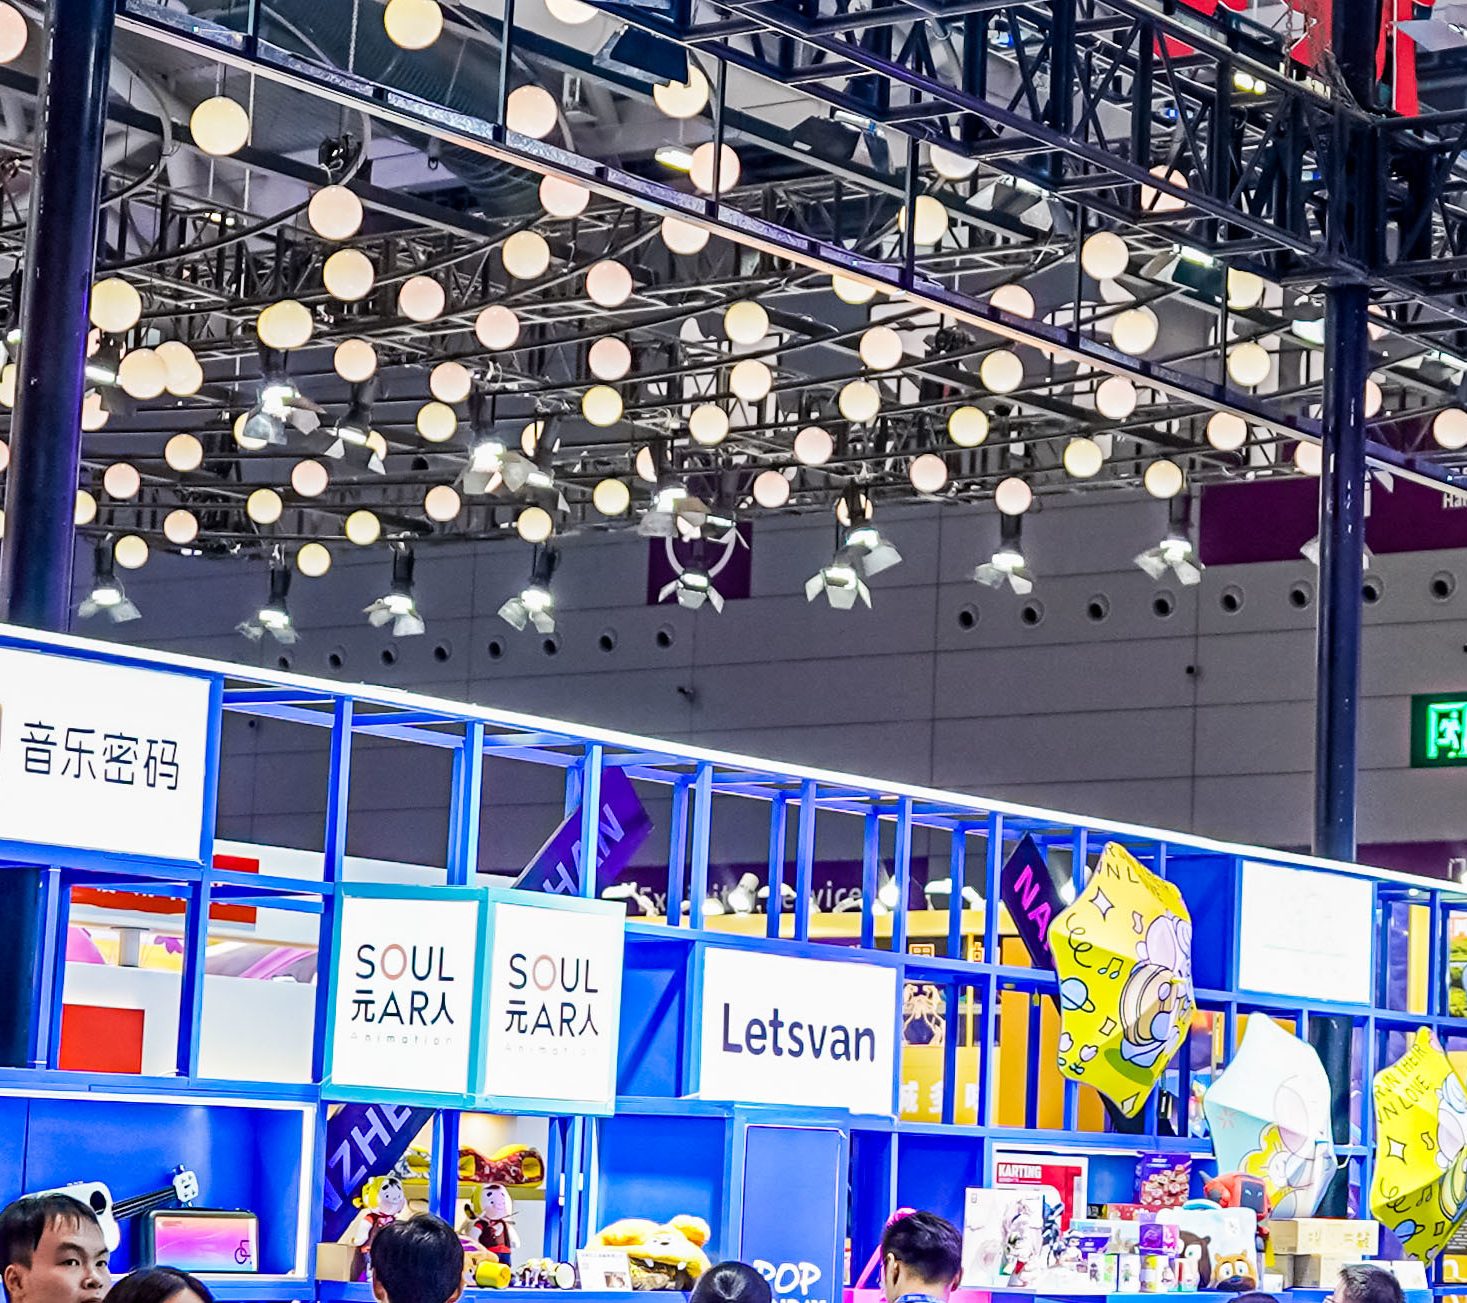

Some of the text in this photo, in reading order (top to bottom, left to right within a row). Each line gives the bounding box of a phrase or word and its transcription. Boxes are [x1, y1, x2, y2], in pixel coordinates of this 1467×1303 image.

[19, 720, 181, 793] 音乐密码
[355, 943, 455, 982] SOUL
[508, 952, 599, 994] SOUL
[351, 989, 455, 1027] 元AR人
[504, 999, 599, 1037] 元AR人
[721, 1001, 878, 1064] Letsvan
[753, 1259, 822, 1296] POP
